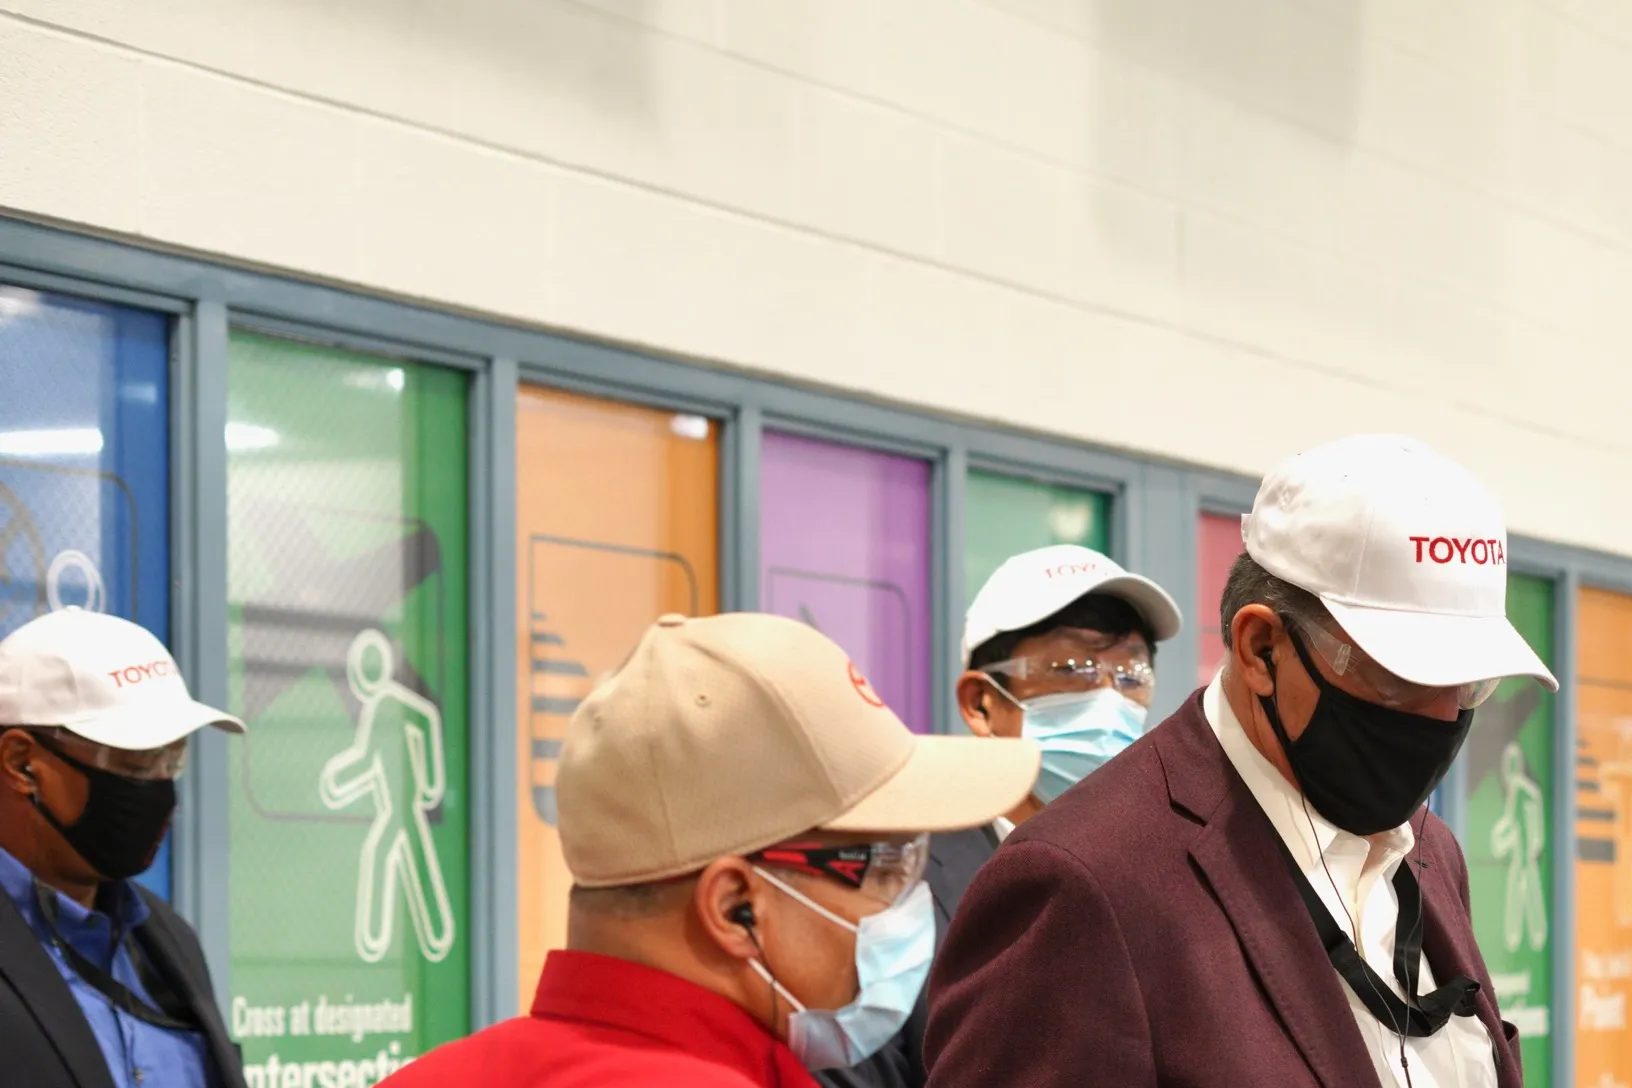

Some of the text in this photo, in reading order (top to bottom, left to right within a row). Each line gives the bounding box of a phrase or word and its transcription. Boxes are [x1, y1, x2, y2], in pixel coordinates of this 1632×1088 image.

[1409, 536, 1506, 565] TOYOTA
[232, 993, 412, 1042] Cross at designated
